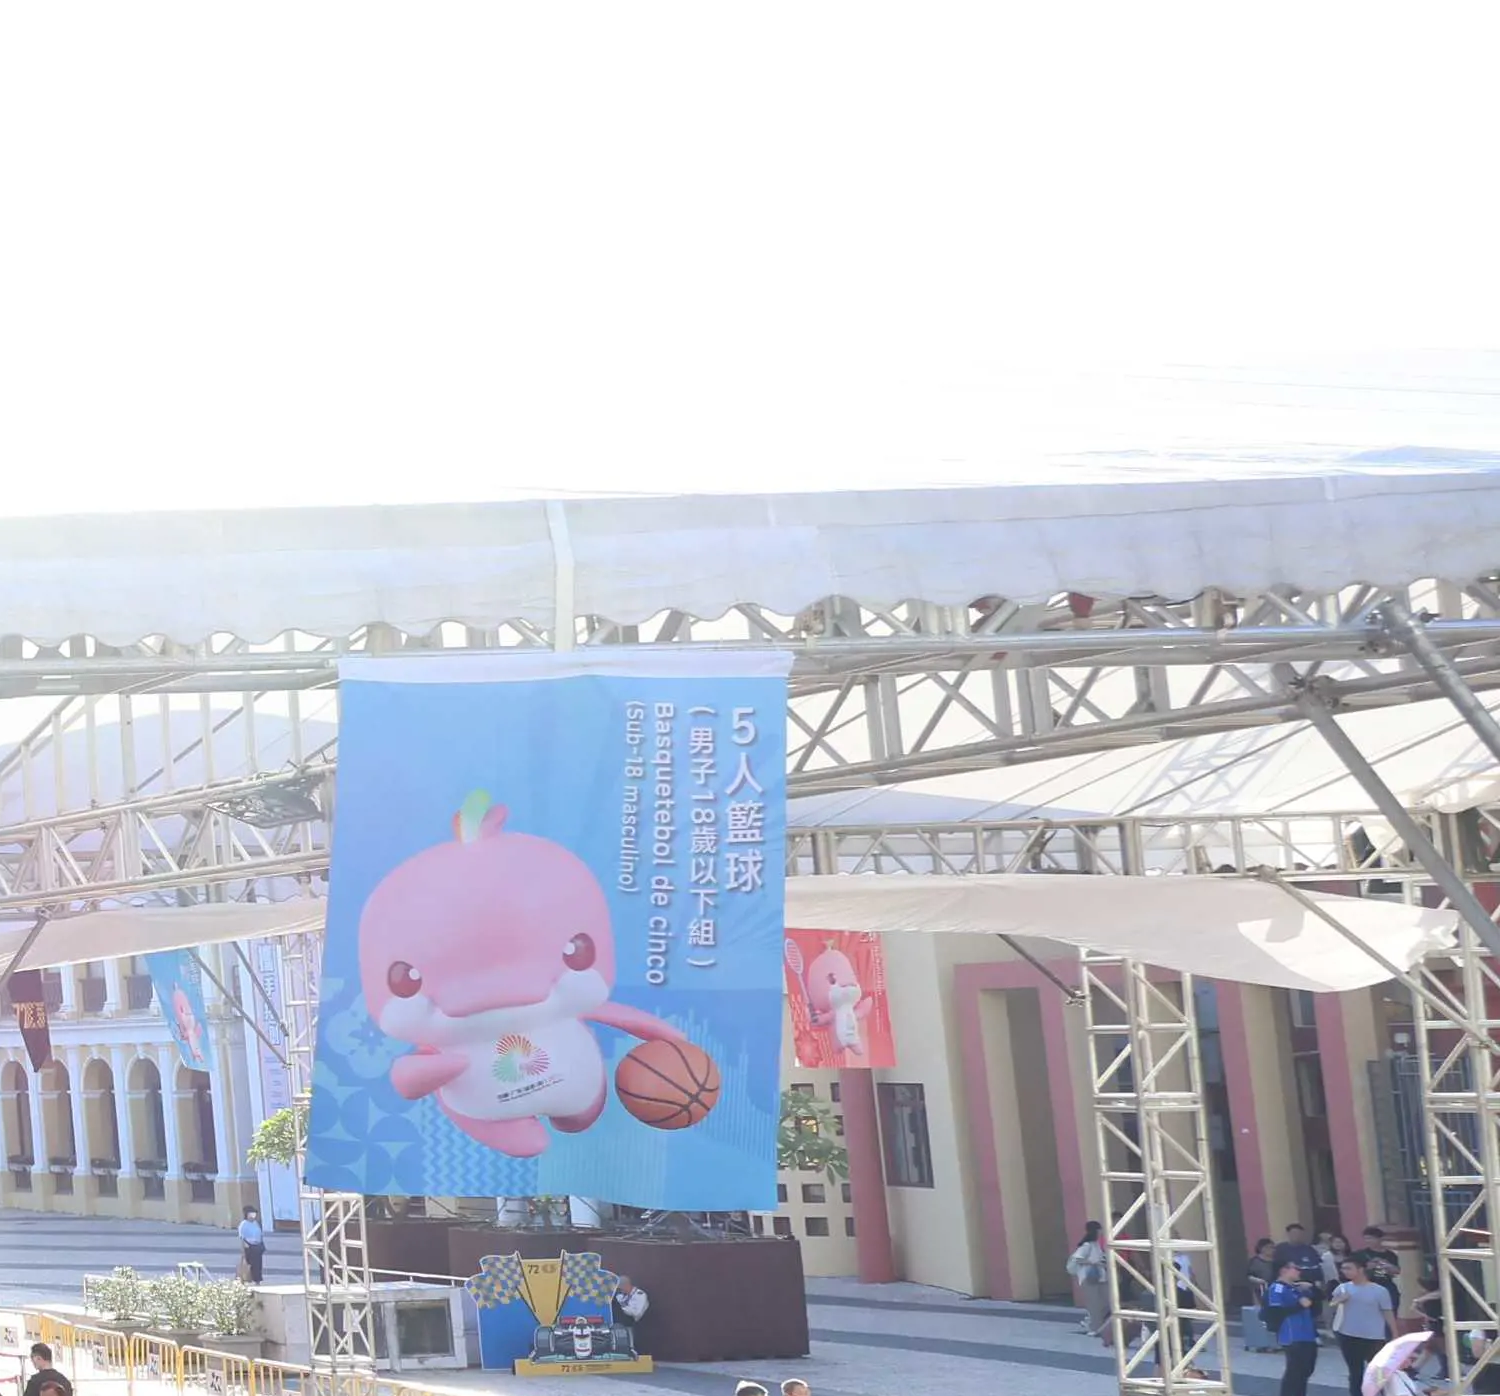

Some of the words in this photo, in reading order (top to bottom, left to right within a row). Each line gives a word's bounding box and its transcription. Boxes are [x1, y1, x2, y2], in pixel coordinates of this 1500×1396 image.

[651, 703, 675, 864] Basquetebol
[725, 707, 763, 893] 5人籃球
[617, 786, 641, 893] masculino)
[649, 875, 675, 906] de
[645, 916, 673, 985] cinco
[528, 1264, 539, 1274] 72
